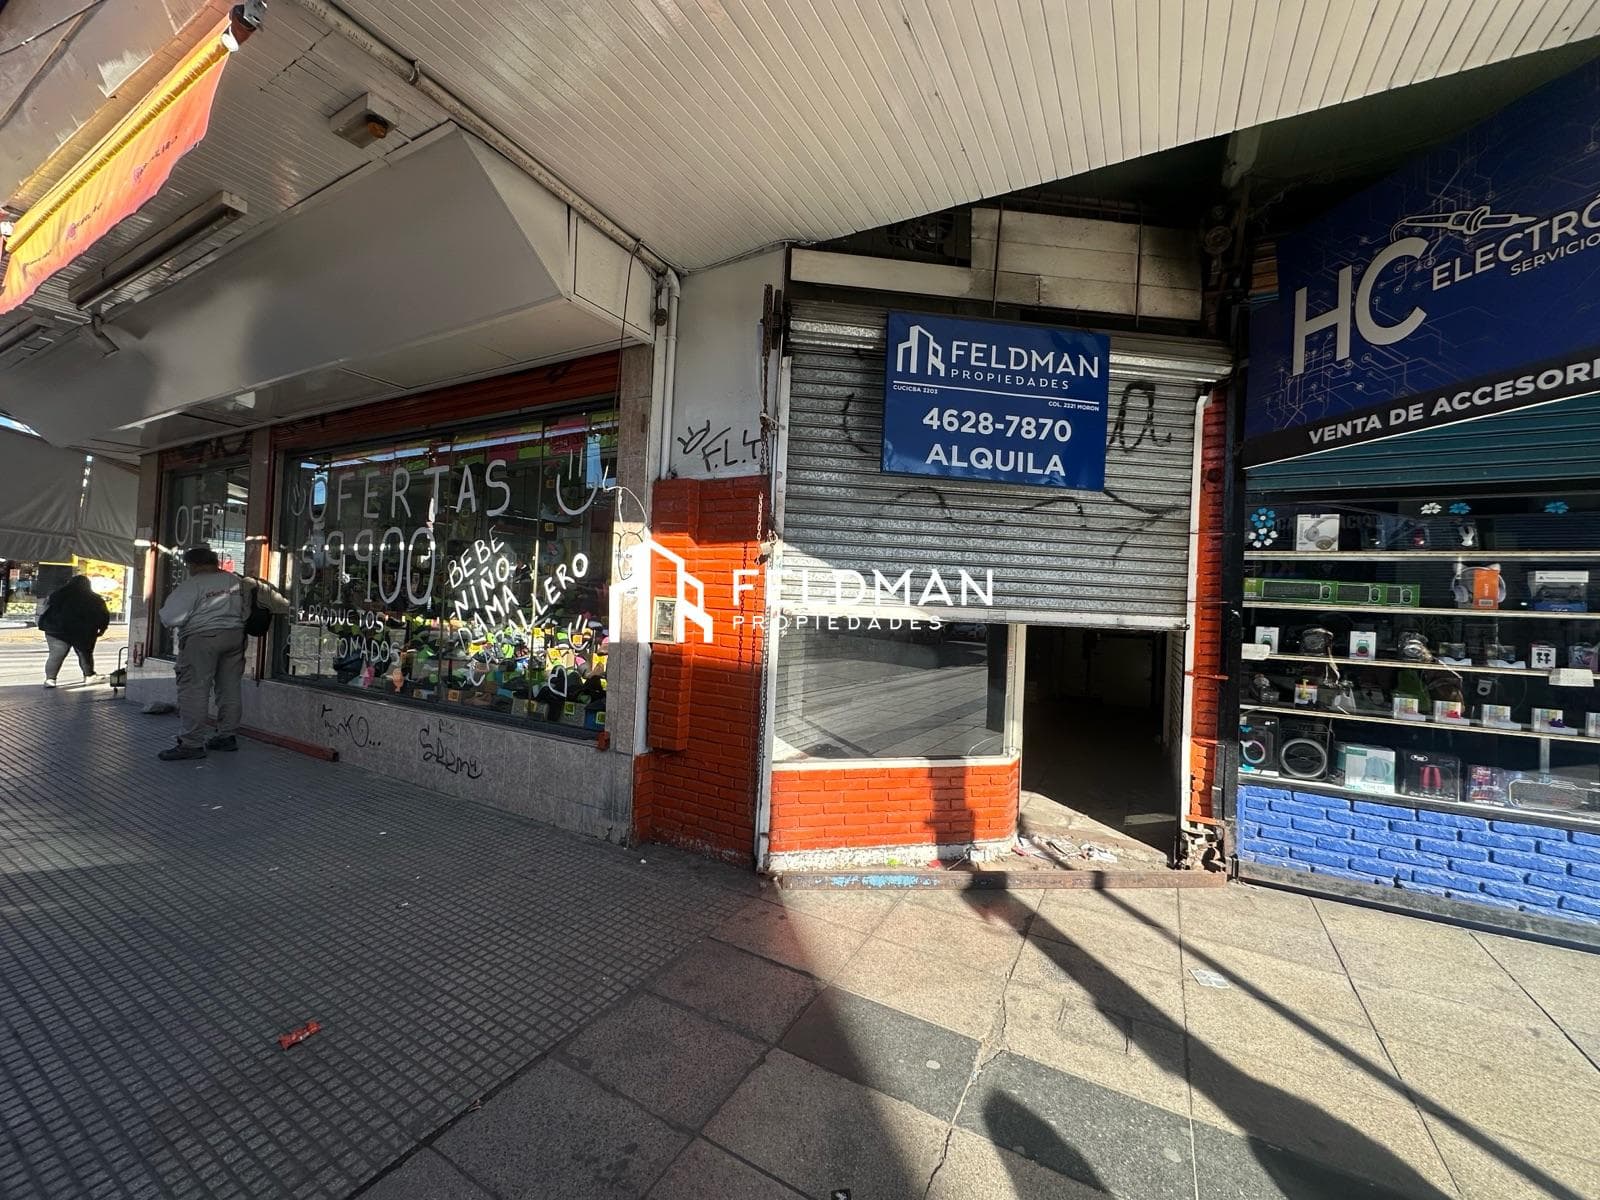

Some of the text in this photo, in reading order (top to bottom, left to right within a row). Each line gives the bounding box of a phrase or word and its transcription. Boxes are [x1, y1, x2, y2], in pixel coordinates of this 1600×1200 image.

[1292, 236, 1429, 377] HC
[951, 341, 1099, 378] FELDMAN
[951, 369, 1069, 390] PROPIEDADES
[922, 407, 1072, 442] 4628-7870
[1308, 415, 1383, 445] VENTA
[1389, 402, 1424, 426] DE
[925, 443, 1066, 477] ALQUILA
[308, 459, 511, 522] OFERTAS
[448, 525, 505, 588] BEBE
[308, 604, 384, 633] PRODUCTOS
